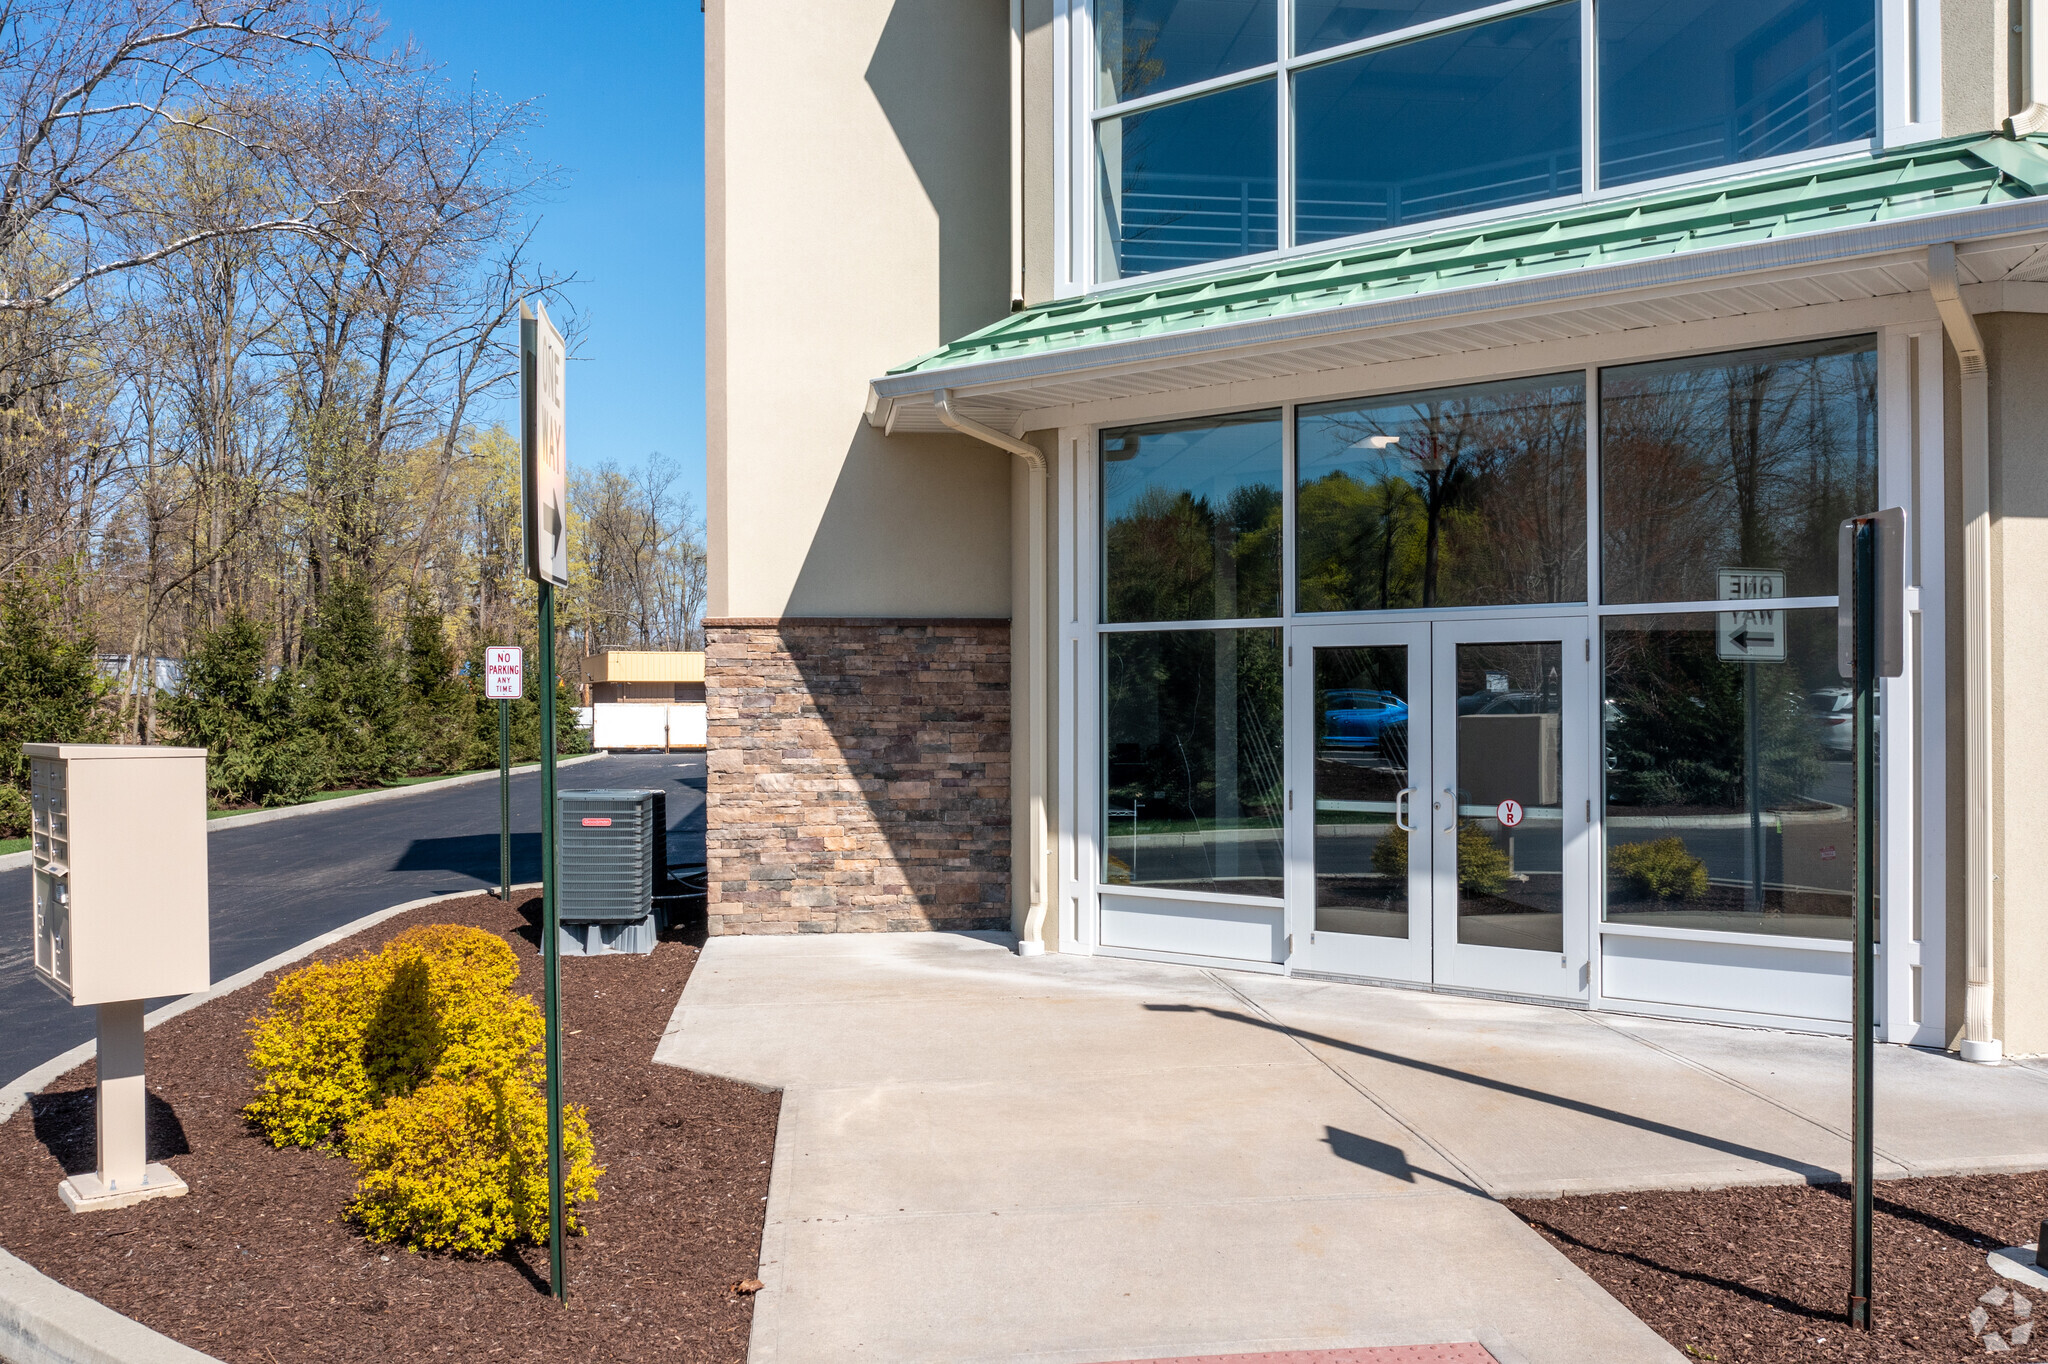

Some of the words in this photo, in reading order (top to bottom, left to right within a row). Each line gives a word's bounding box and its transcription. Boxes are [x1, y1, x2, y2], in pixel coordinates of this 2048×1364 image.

[542, 335, 561, 409] ONE
[541, 404, 562, 475] WAY
[497, 652, 511, 663] NO
[489, 665, 519, 675] PARKING
[497, 676, 511, 684] ANY
[496, 685, 513, 693] TIME
[1506, 802, 1514, 813] V
[1506, 813, 1514, 823] R
